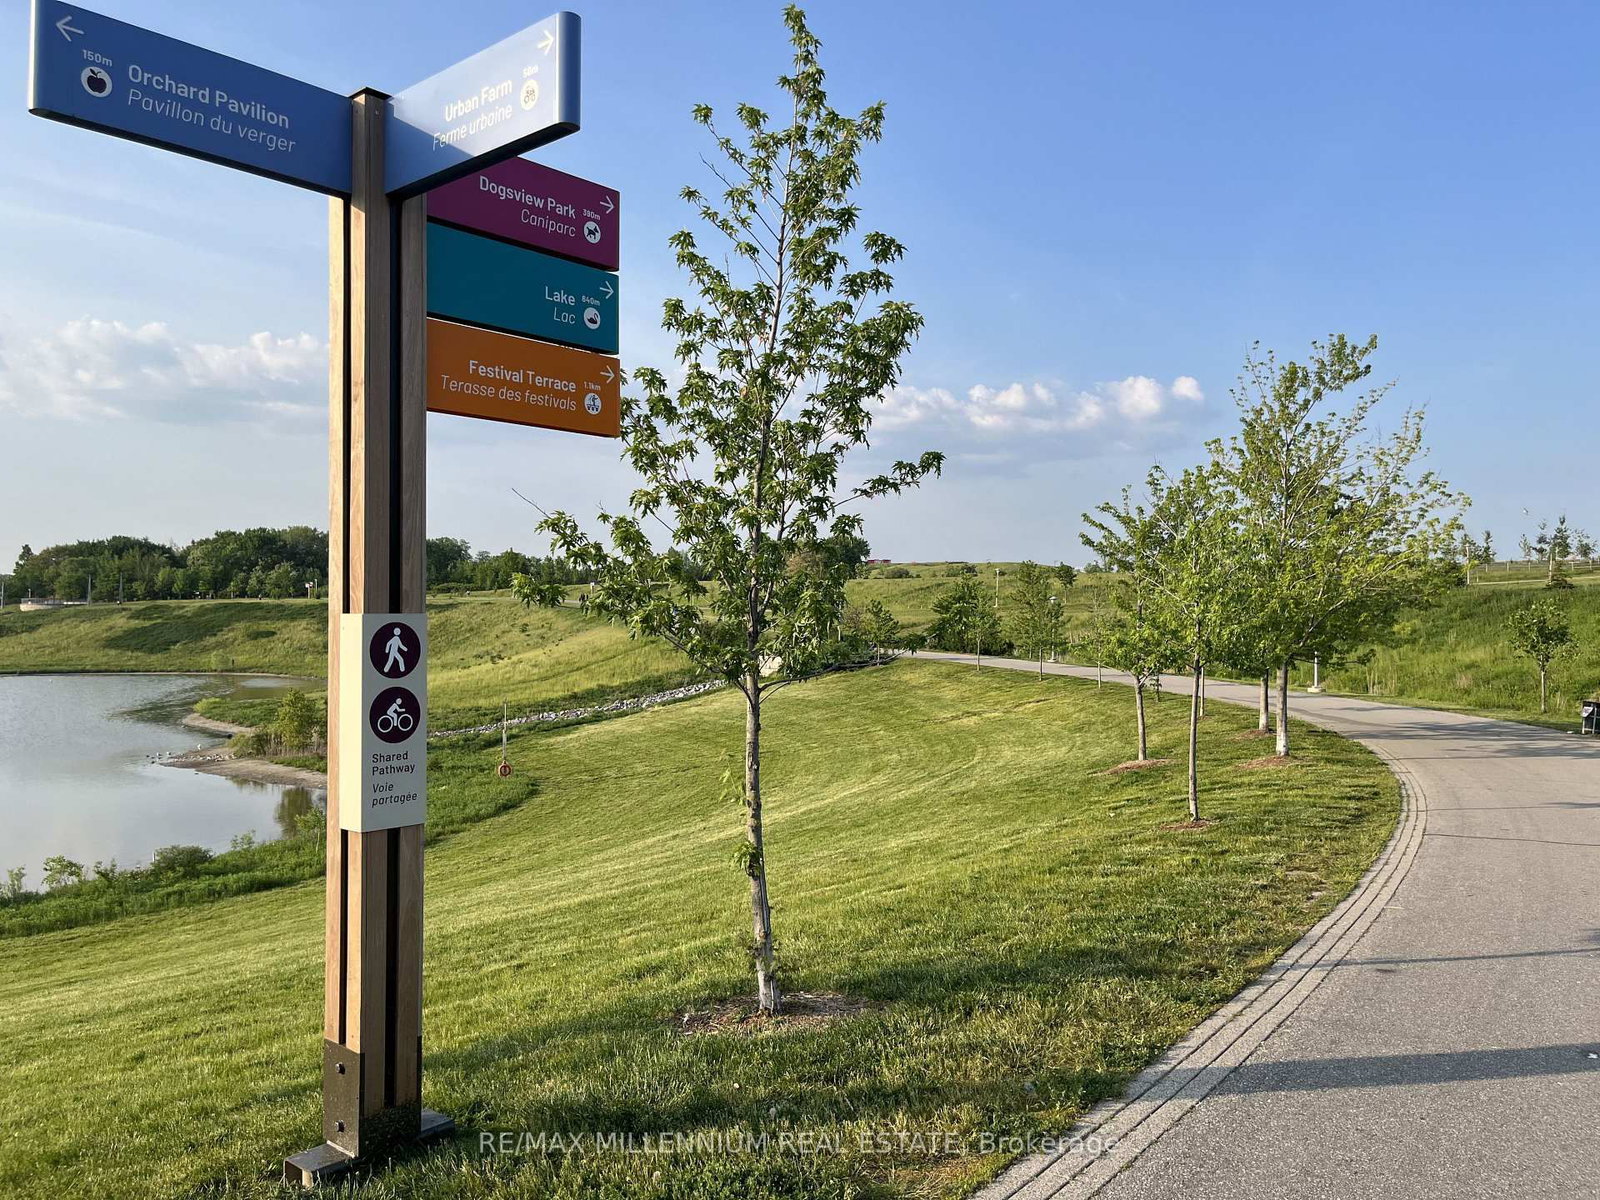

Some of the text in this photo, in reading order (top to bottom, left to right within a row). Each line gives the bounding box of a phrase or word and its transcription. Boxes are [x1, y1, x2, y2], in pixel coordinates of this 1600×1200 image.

[82, 49, 113, 68] 150m
[128, 65, 290, 129] Orchard Pavilion
[445, 80, 513, 122] Urban Farm
[128, 89, 296, 153] Pavillon du verger
[433, 104, 513, 150] Ferme urbaine
[479, 175, 576, 219] Dogsview Park
[521, 209, 576, 237] Caniparc
[545, 286, 575, 306] Lake
[553, 307, 576, 324] Lac
[469, 360, 577, 393] Festival Terrace
[441, 374, 577, 411] Terasse des festivals
[372, 751, 408, 763] Shared
[372, 764, 415, 776] Pathway
[372, 782, 394, 793] Voie
[372, 792, 418, 808] partagée
